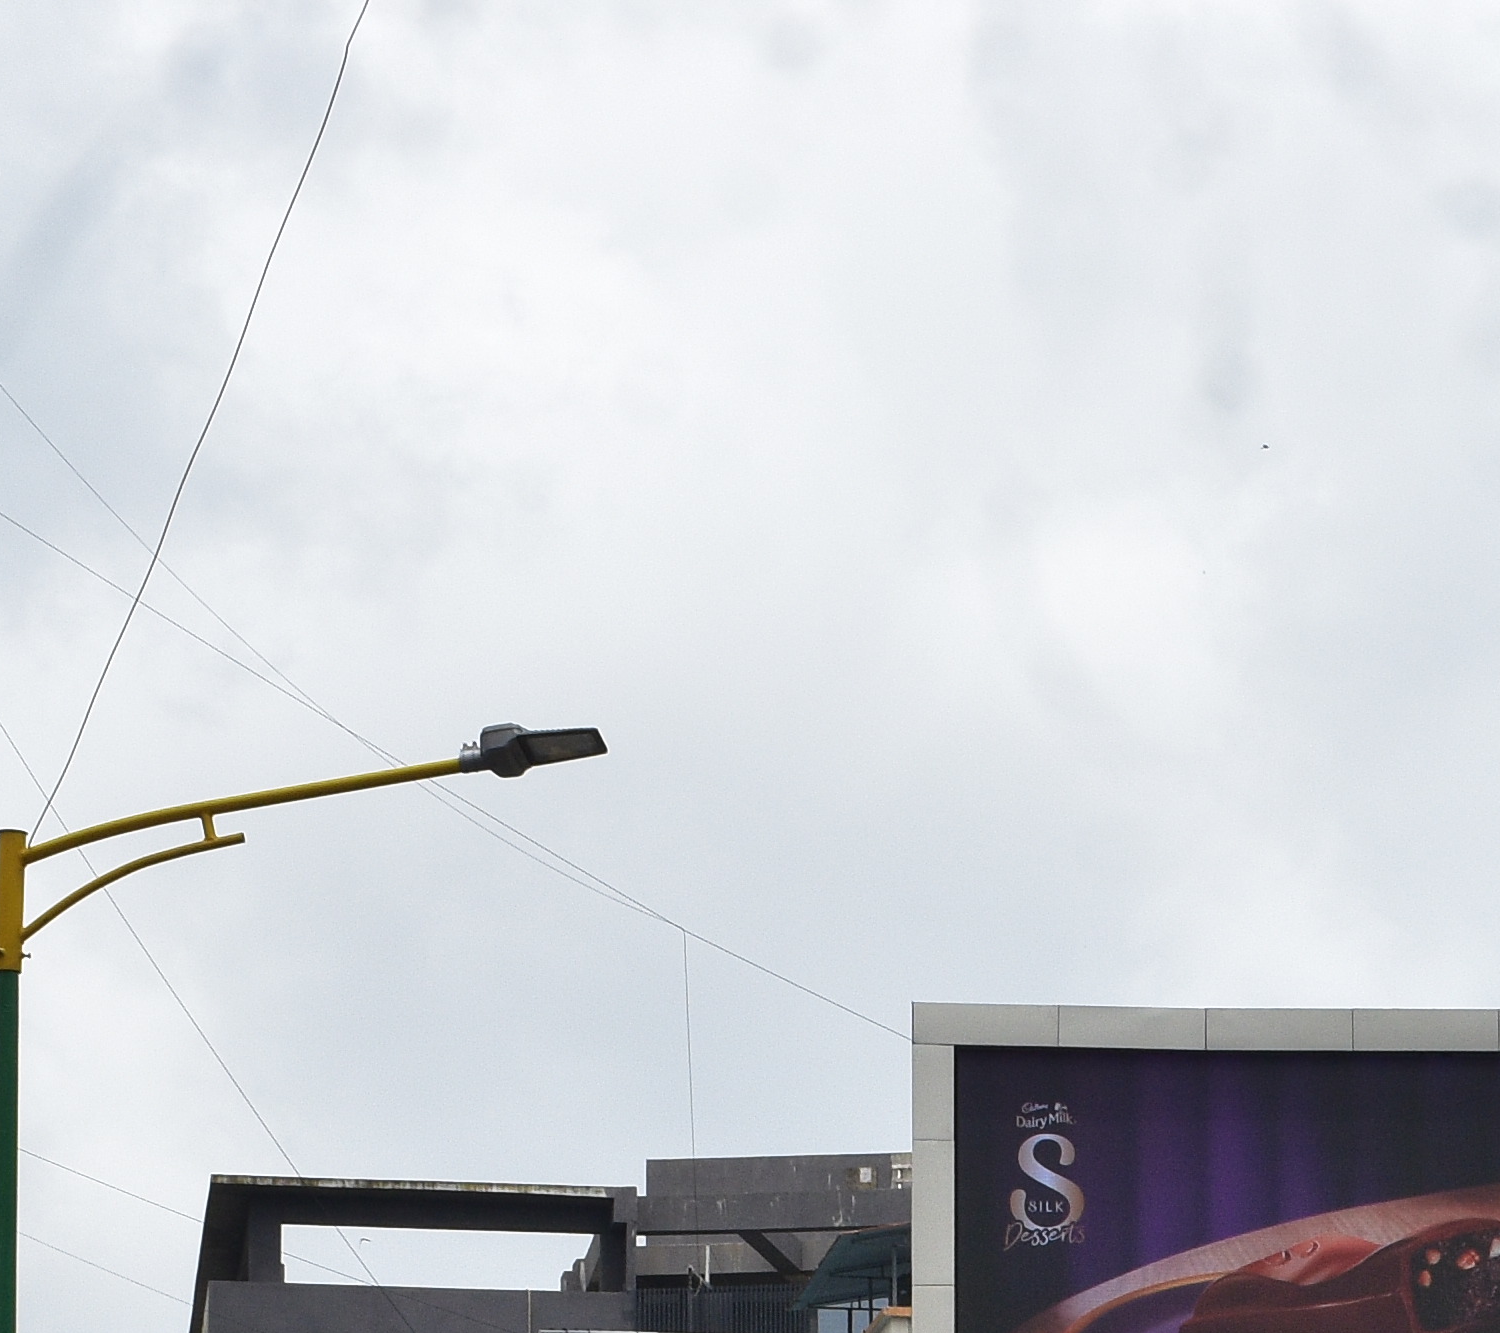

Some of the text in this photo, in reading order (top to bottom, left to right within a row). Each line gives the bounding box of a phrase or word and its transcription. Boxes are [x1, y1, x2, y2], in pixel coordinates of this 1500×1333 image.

[1016, 1115, 1048, 1129] Dairy
[1028, 1201, 1064, 1213] SILK
[1004, 1221, 1086, 1251] Desserts
